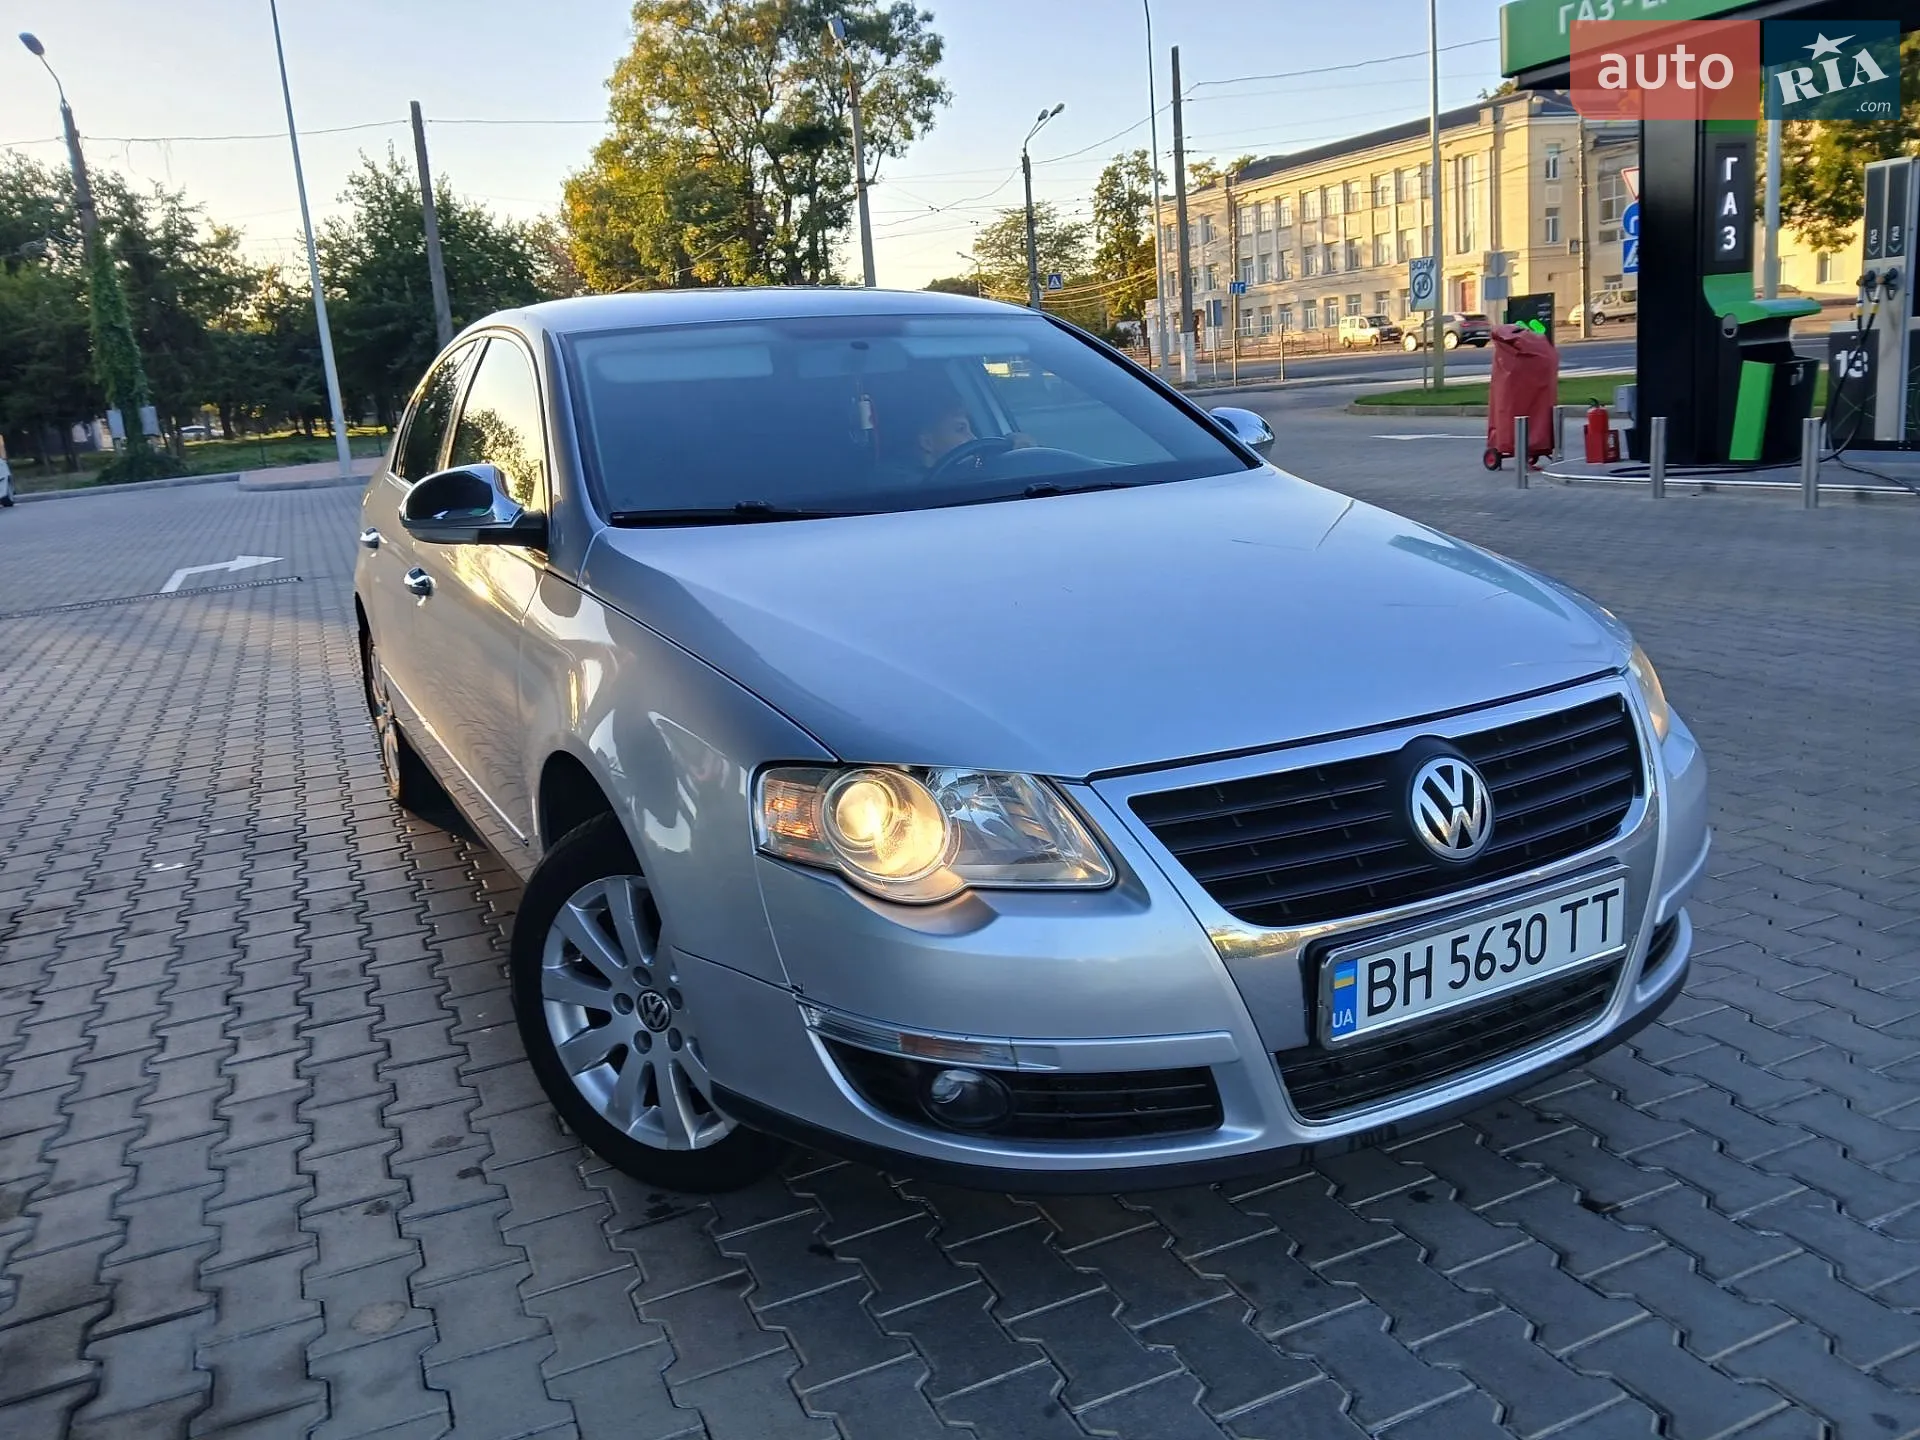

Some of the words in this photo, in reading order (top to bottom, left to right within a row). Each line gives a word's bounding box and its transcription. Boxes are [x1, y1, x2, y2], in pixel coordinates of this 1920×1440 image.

[1723, 157, 1739, 250] ГАЗ
[1367, 945, 1434, 1017] BH
[1448, 912, 1548, 990] 5630
[1560, 887, 1620, 953] TT
[1332, 1008, 1354, 1029] UA
